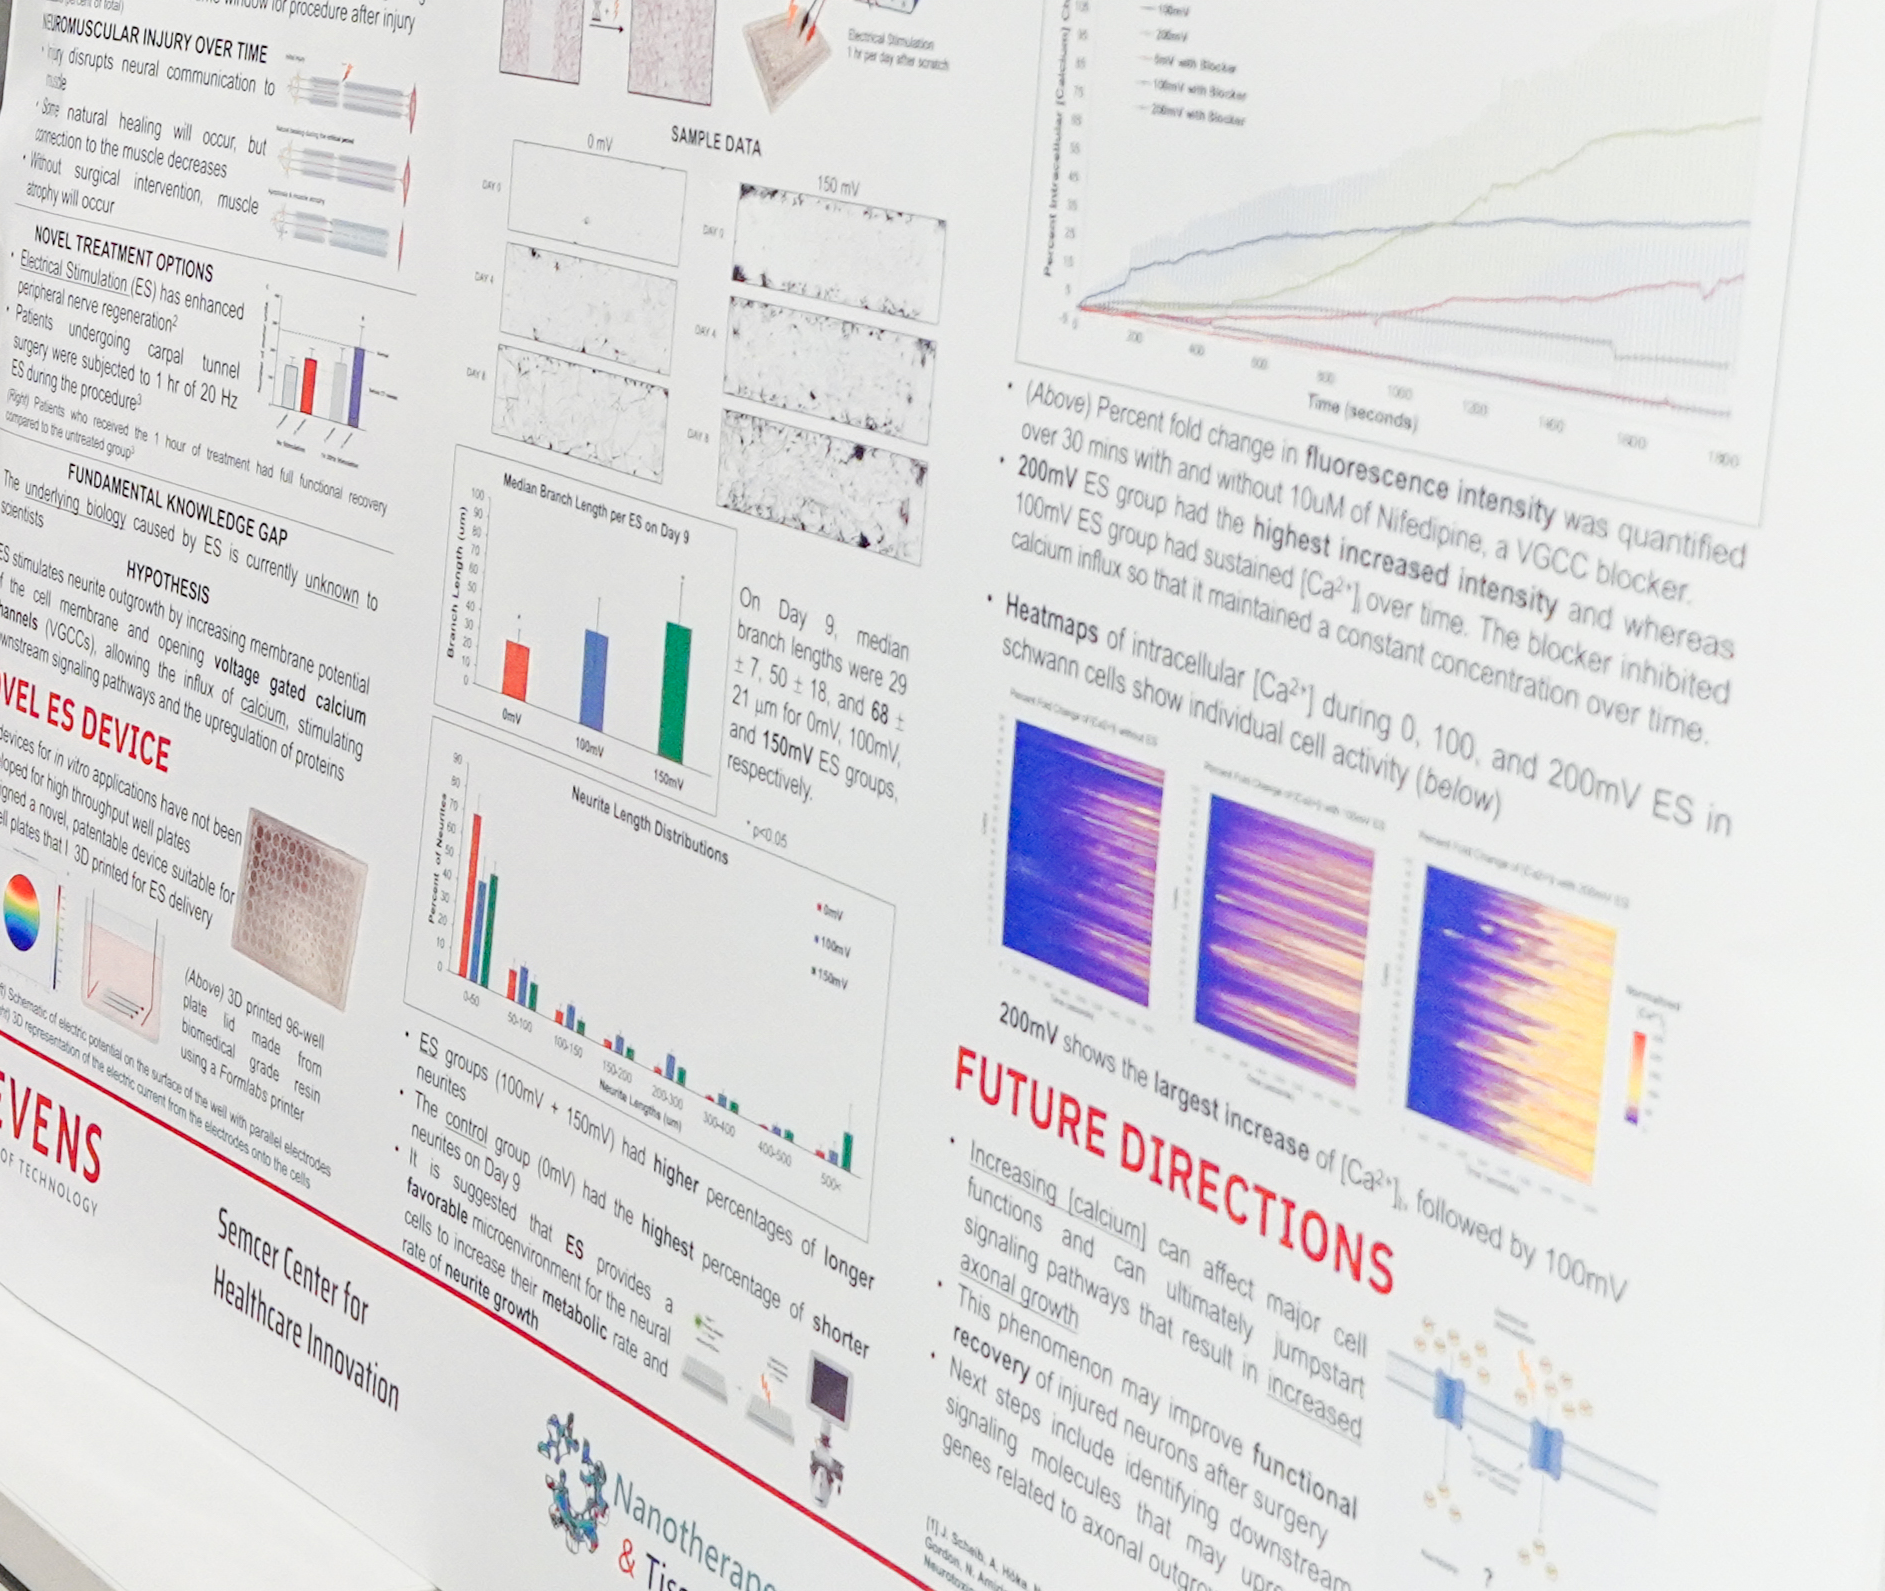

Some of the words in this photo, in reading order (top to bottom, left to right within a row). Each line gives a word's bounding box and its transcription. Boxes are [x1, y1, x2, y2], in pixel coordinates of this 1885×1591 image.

[142, 28, 193, 52] INJURY
[195, 35, 233, 58] OVER
[237, 41, 268, 64] TIME
[671, 125, 721, 151] SAMPLE
[725, 134, 762, 157] DATA
[34, 225, 72, 251] NOVEL
[74, 234, 154, 271] TREATMENT
[156, 252, 214, 283] OPTIONS
[66, 462, 163, 512] FUNDAMENTAL
[166, 493, 255, 541] KNOWLEDGE
[258, 522, 288, 547] GAP
[503, 472, 538, 495] Median
[539, 483, 573, 507] Branch
[575, 495, 608, 520] Length
[1305, 444, 1450, 501] fluorescence
[1457, 478, 1557, 532] intensity
[126, 560, 210, 607] HYPOTHESIS
[1006, 592, 1099, 645] Heatmaps
[46, 691, 76, 732] ES
[79, 704, 172, 773] DEVICE
[502, 707, 522, 725] 0mV
[575, 736, 605, 759] 100mV
[653, 767, 685, 791] 150mV
[999, 998, 1059, 1046] 200mV
[1062, 1031, 1118, 1069] shows
[1121, 1057, 1149, 1088] the
[1154, 1070, 1219, 1122] largest
[1224, 1102, 1310, 1162] increase
[0, 1147, 15, 1165] OF
[18, 1158, 98, 1216] TECHNOLOGY
[955, 1045, 1108, 1162] FUTURE
[1116, 1118, 1394, 1297] DIRECTIONS
[217, 1206, 280, 1269] Semcer
[283, 1246, 339, 1307] Center
[343, 1280, 369, 1325] for
[824, 1244, 875, 1291] longer
[214, 1260, 302, 1348] Healthcare
[307, 1322, 399, 1412] Innovation
[1252, 1441, 1358, 1521] functional
[618, 1538, 635, 1579] &
